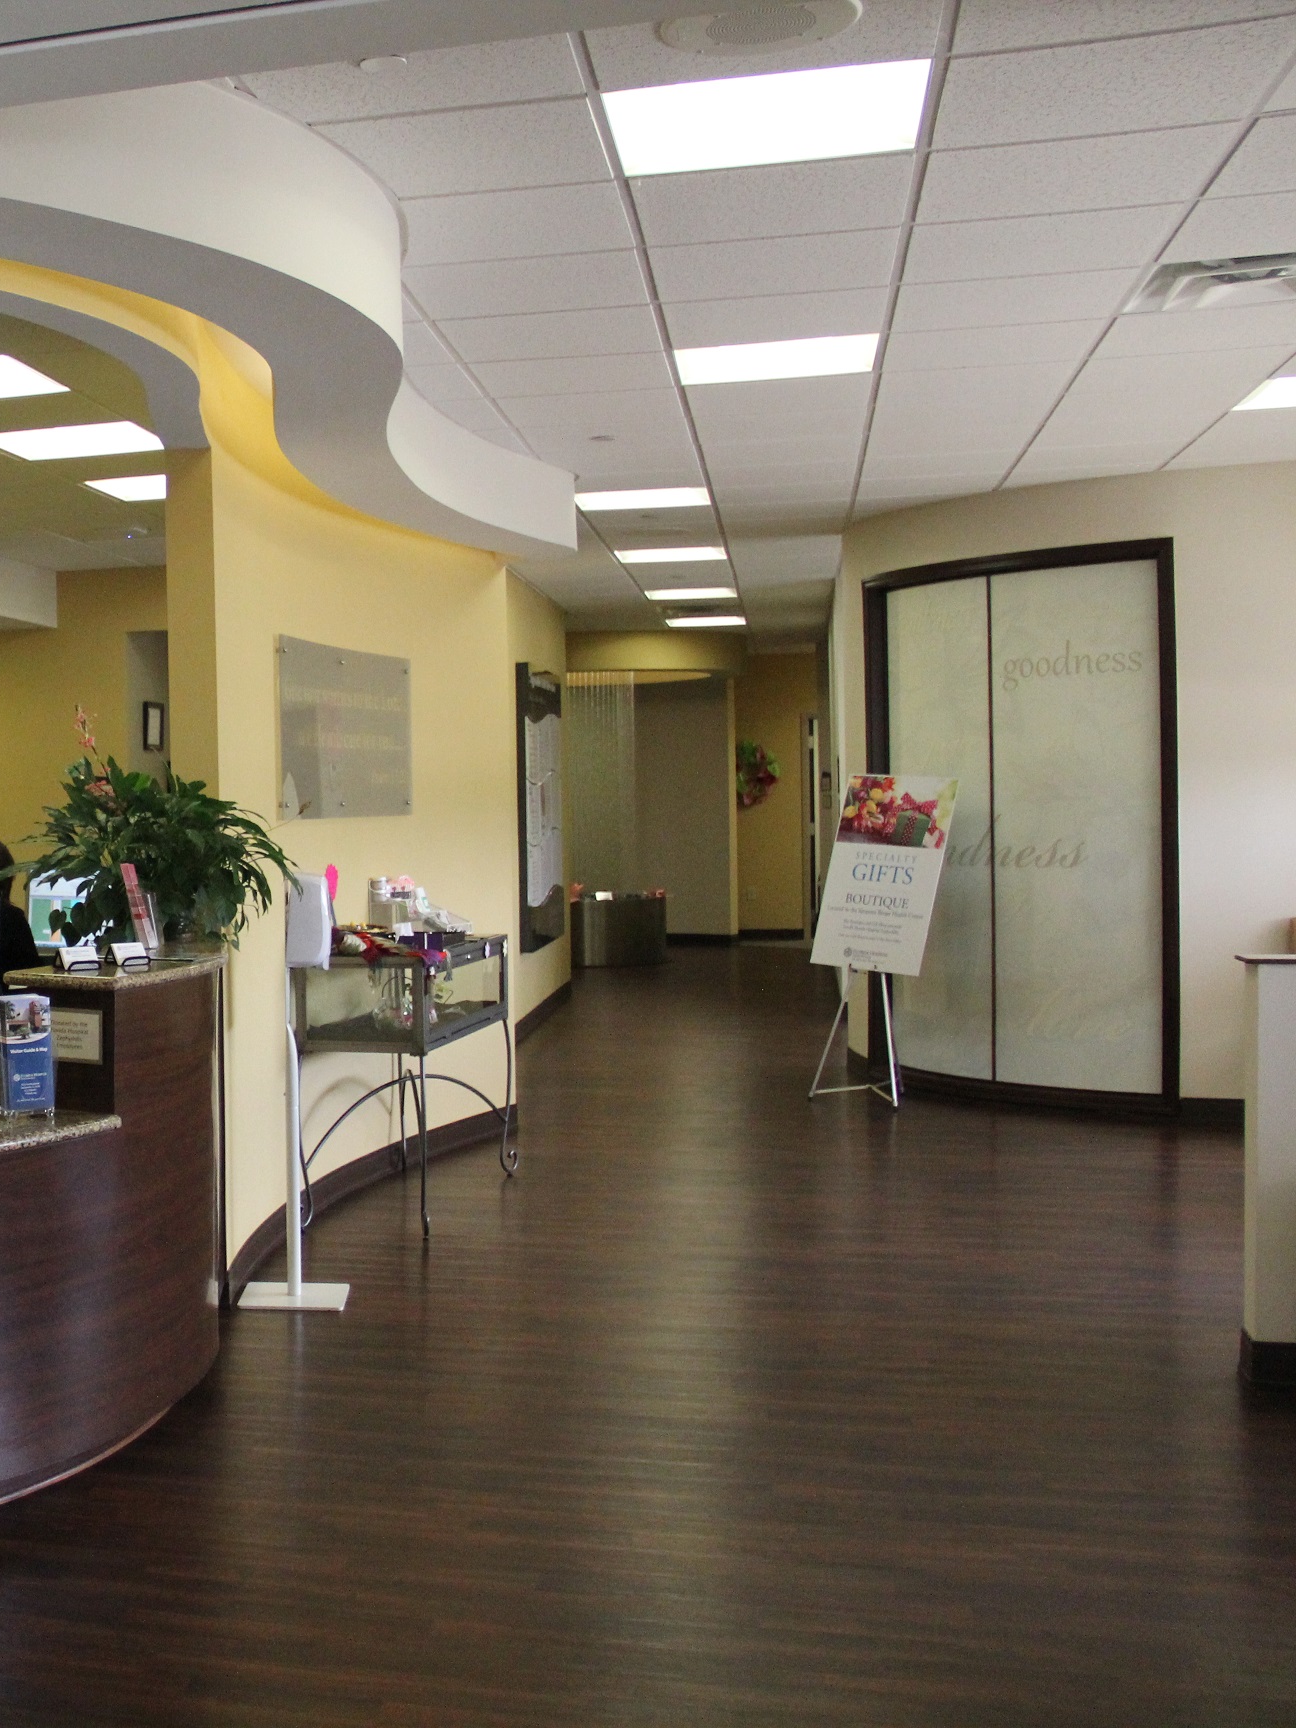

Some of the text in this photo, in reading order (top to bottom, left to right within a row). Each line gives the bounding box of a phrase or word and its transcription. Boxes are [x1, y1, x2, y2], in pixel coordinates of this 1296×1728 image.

[1001, 638, 1143, 693] goodness
[945, 812, 1090, 869] ndness
[855, 851, 918, 864] SPECIALTY
[852, 862, 915, 886] GIFTS
[845, 892, 910, 910] BOUTIQUE
